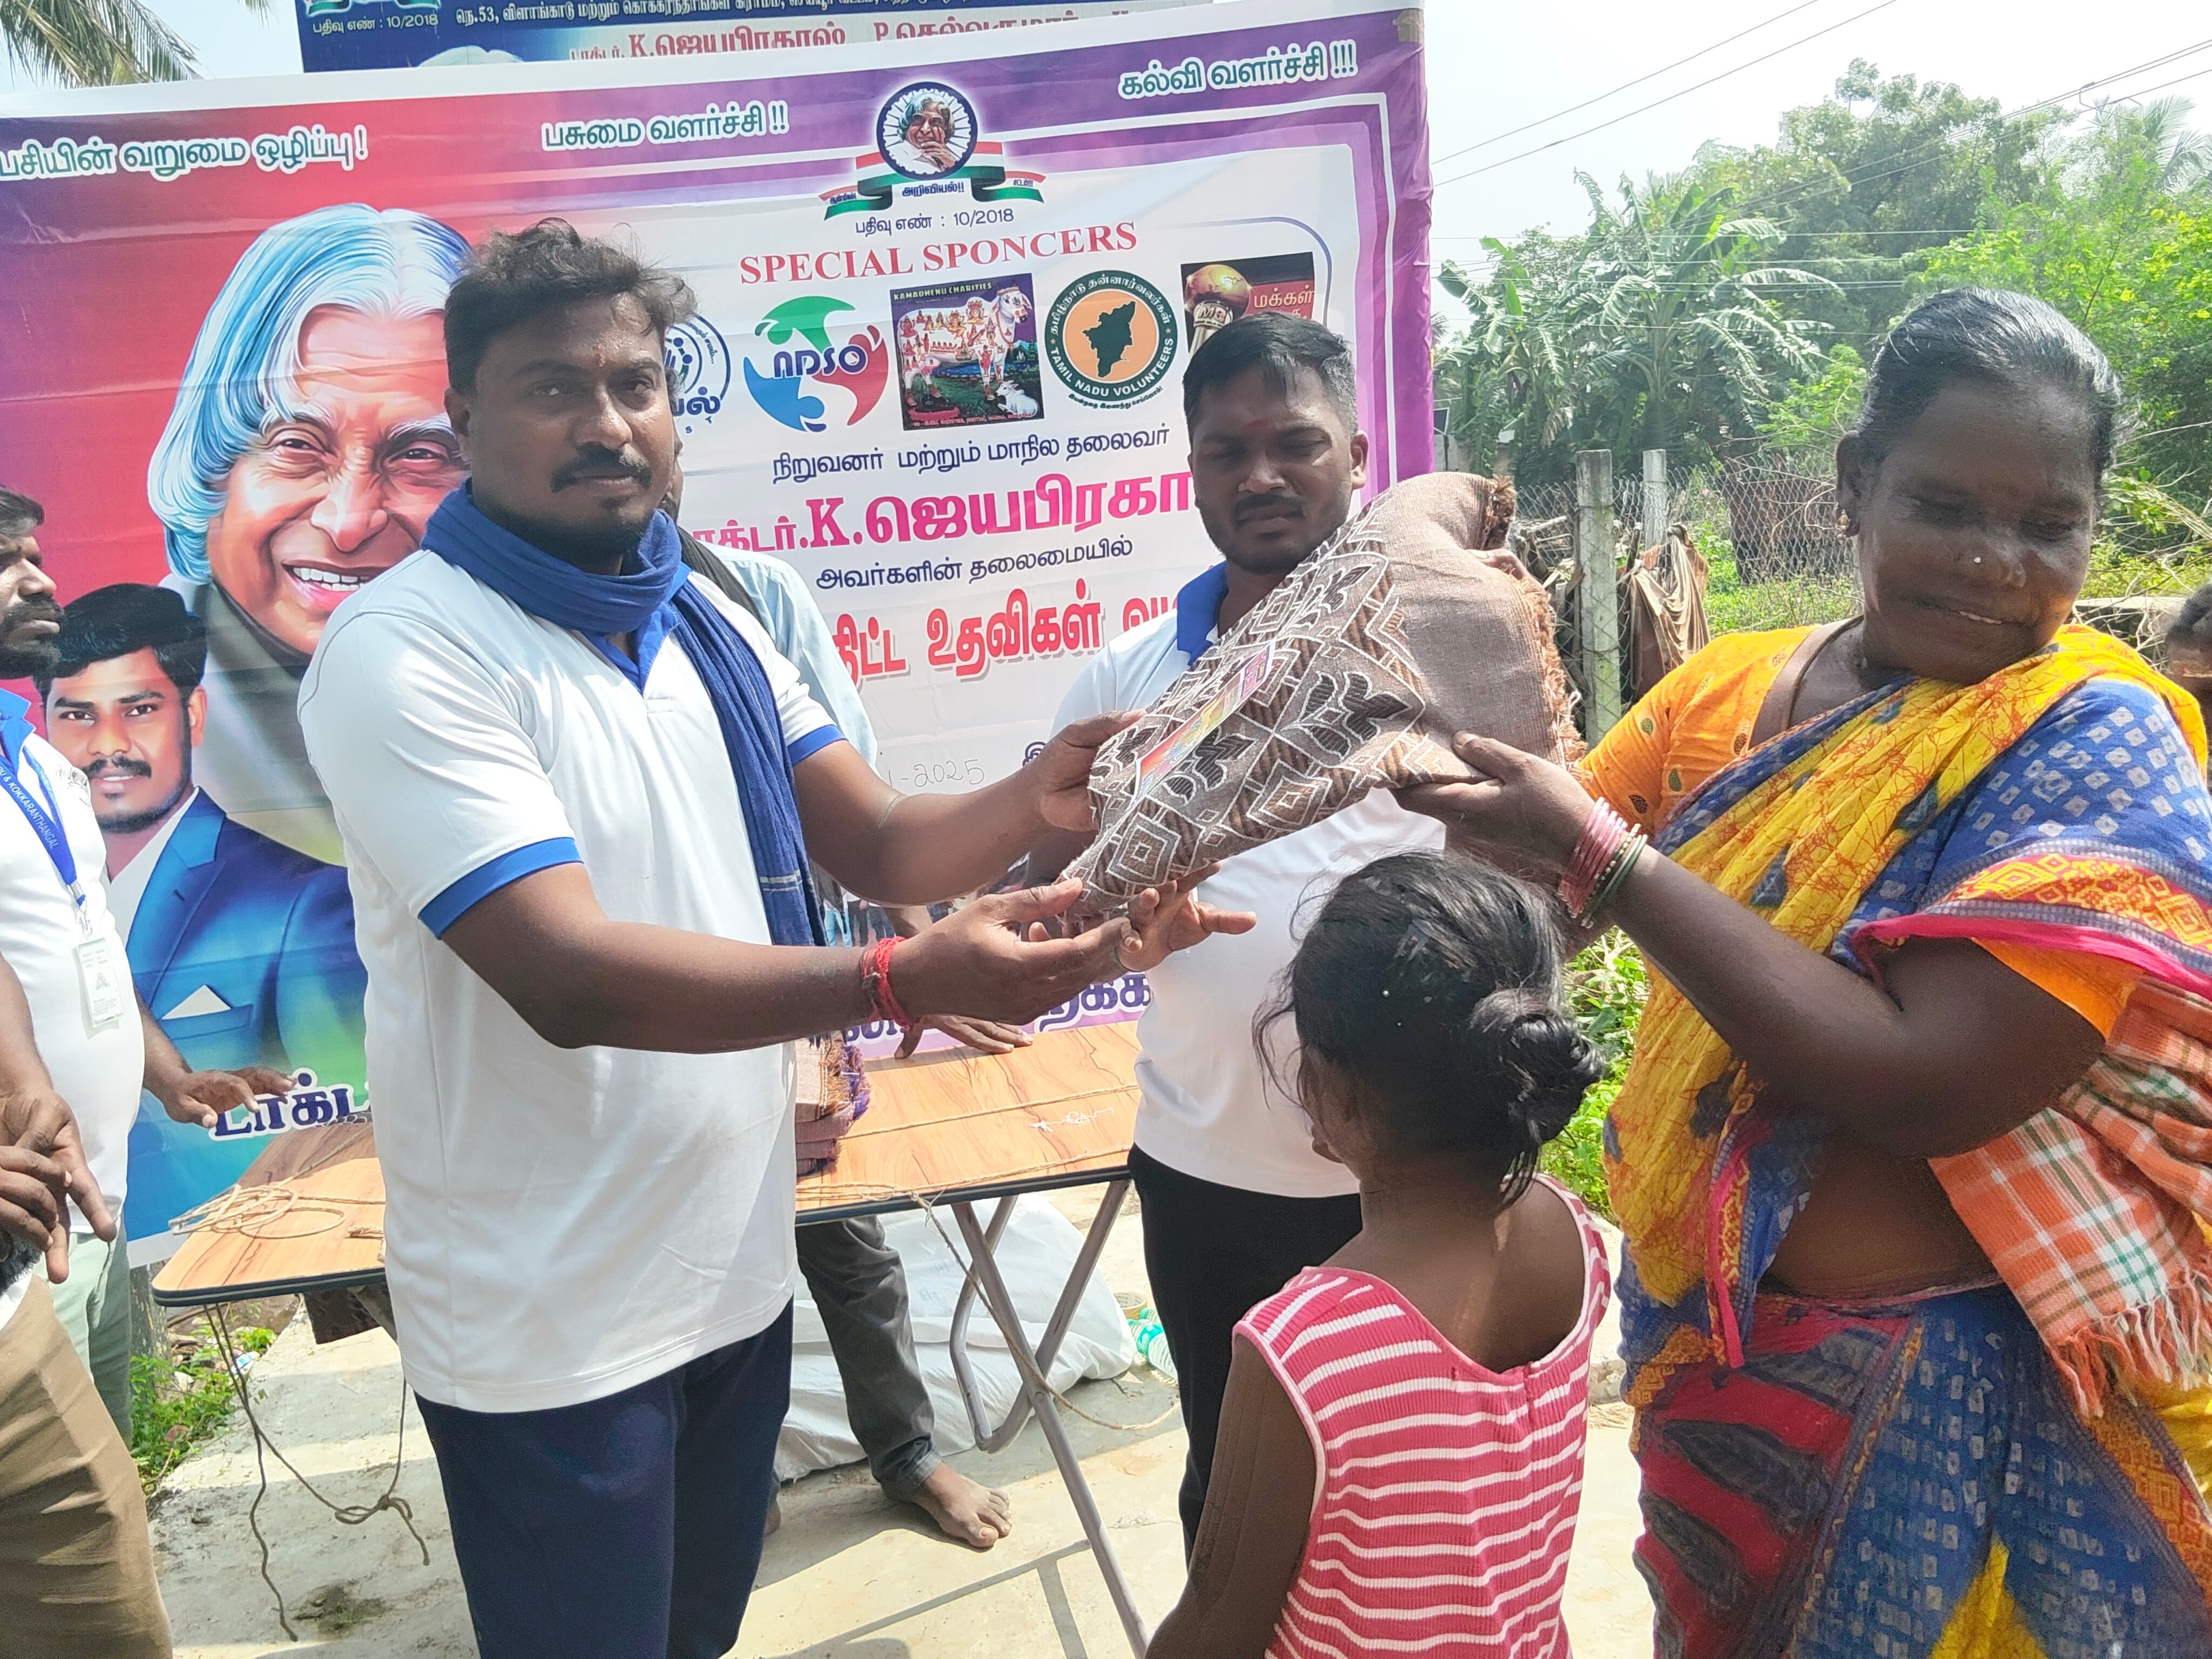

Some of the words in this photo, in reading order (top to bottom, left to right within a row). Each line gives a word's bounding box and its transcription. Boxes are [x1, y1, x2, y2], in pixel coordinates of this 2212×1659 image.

[313, 18, 344, 36] பதிவு
[347, 15, 375, 31] எண்
[386, 13, 438, 29] 10/2018
[1120, 59, 1203, 96] கல்வி
[1211, 45, 1324, 86] வளர்ச்சி
[544, 120, 641, 148] பசுமை
[649, 104, 763, 139] வளர்ச்சி
[0, 140, 113, 177] பசியின்
[123, 139, 247, 177] வறுமை
[256, 128, 351, 169] ஒழிப்பு
[855, 217, 892, 237] பதிவு
[895, 213, 933, 231] எண்
[953, 208, 1014, 228] 10/2018
[740, 246, 914, 285] SPECIAL
[922, 222, 1138, 272] SPONCERS
[893, 287, 948, 301] KAMADHENU
[948, 282, 993, 295] CHARITIES
[1050, 283, 1086, 336] தமிழ்நாடு
[1253, 284, 1315, 309] மக்கள்
[1050, 347, 1073, 383] TAMIL
[1074, 378, 1109, 397] NADU
[1113, 337, 1174, 397] VOLUNTEERS
[772, 450, 884, 484] நிறுவனர்
[897, 441, 982, 475] மற்றும்
[987, 437, 1060, 465] மாநில
[1066, 423, 1171, 455] தலைவர்
[815, 556, 963, 592] அவர்களின்
[969, 533, 1134, 584] தலைமையில்
[927, 578, 1101, 676] உதவிகள்
[8, 782, 59, 850] KOKKARANTHANGAL
